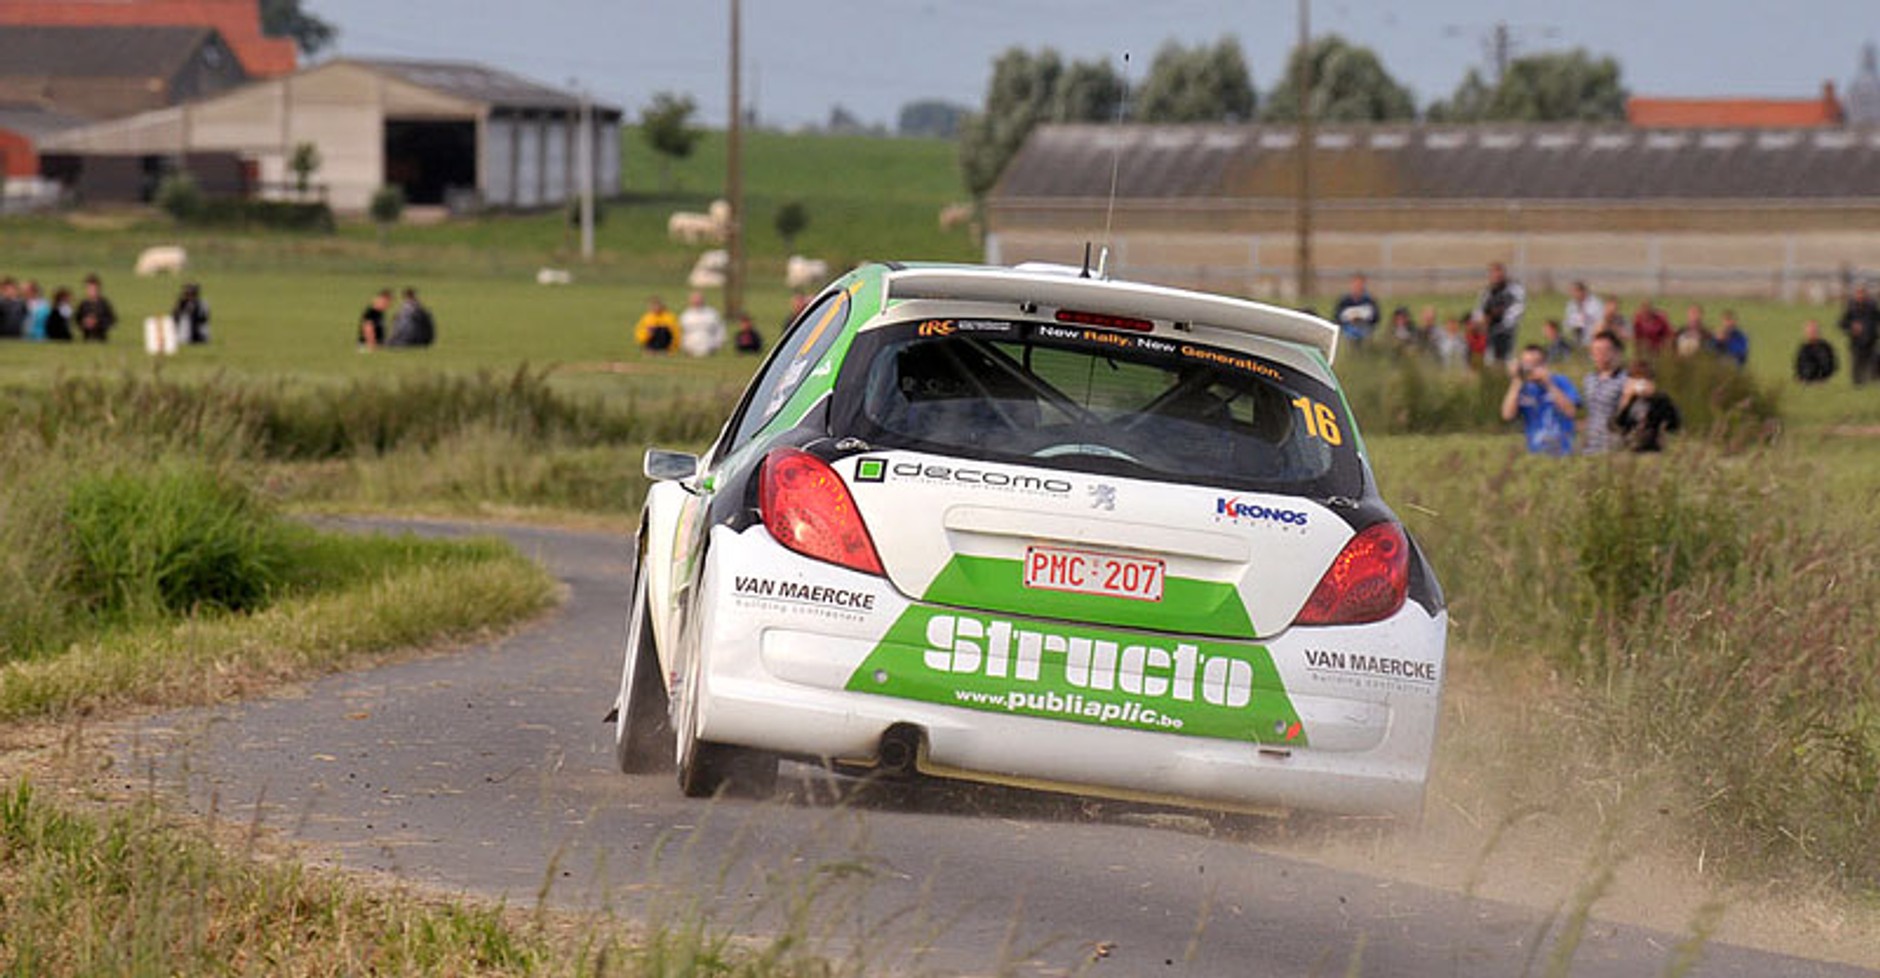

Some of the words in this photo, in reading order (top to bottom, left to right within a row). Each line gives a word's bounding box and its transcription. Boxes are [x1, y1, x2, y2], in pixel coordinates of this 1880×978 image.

[1038, 325, 1079, 338] New
[1082, 330, 1133, 348] Rally.
[1137, 337, 1177, 353] New
[1181, 345, 1284, 382] Generation.
[1292, 396, 1343, 446] 16
[893, 462, 1072, 493] decomo
[1216, 495, 1308, 525] KRONOS
[735, 576, 775, 595] VAN
[778, 581, 876, 610] MAERCKE
[924, 615, 1253, 708] Structo
[1304, 649, 1346, 669] VAN
[1350, 654, 1437, 681] MAERCKE
[954, 688, 1184, 729] www.publiaplic.be
